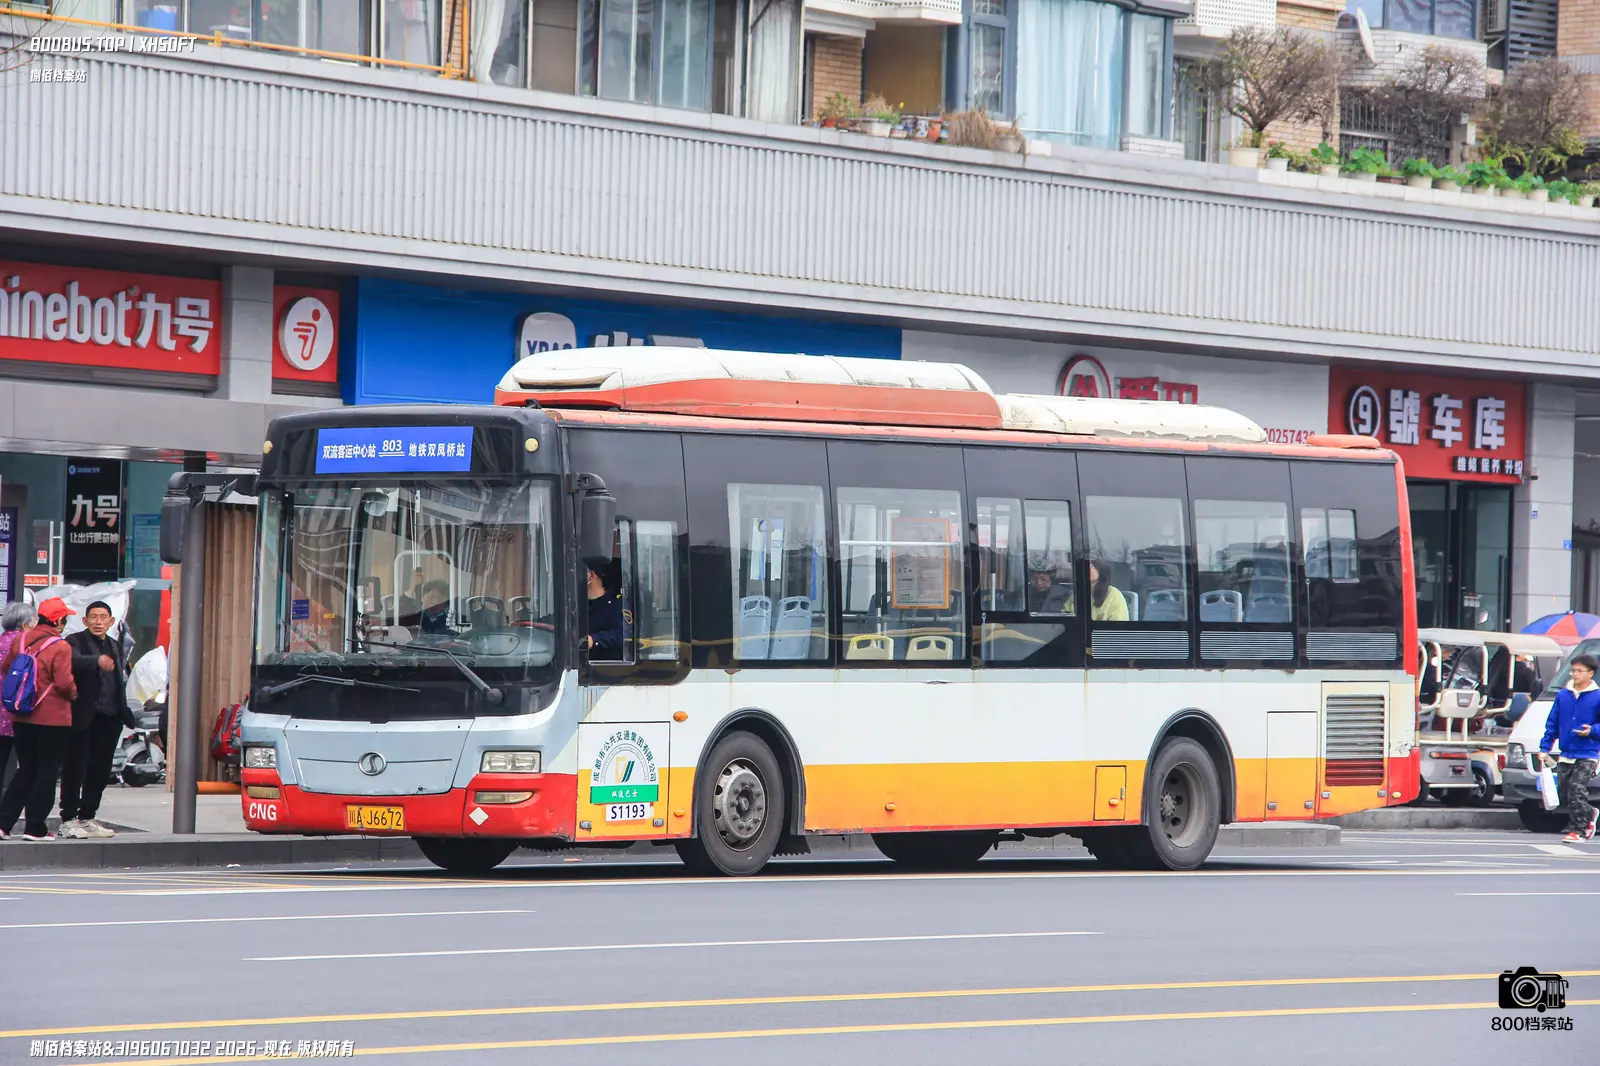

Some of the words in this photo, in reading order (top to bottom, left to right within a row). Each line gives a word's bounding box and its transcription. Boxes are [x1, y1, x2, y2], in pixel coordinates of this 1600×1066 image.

[135, 292, 214, 354] 九号
[322, 444, 376, 460] 双流客运中心站
[382, 439, 403, 452] 803
[408, 442, 466, 458] 地铁双凤桥站
[71, 494, 120, 528] 九号
[592, 729, 657, 782] 成都市公共交通集团有限公司
[249, 802, 277, 821] CNG
[611, 803, 646, 820] S1193
